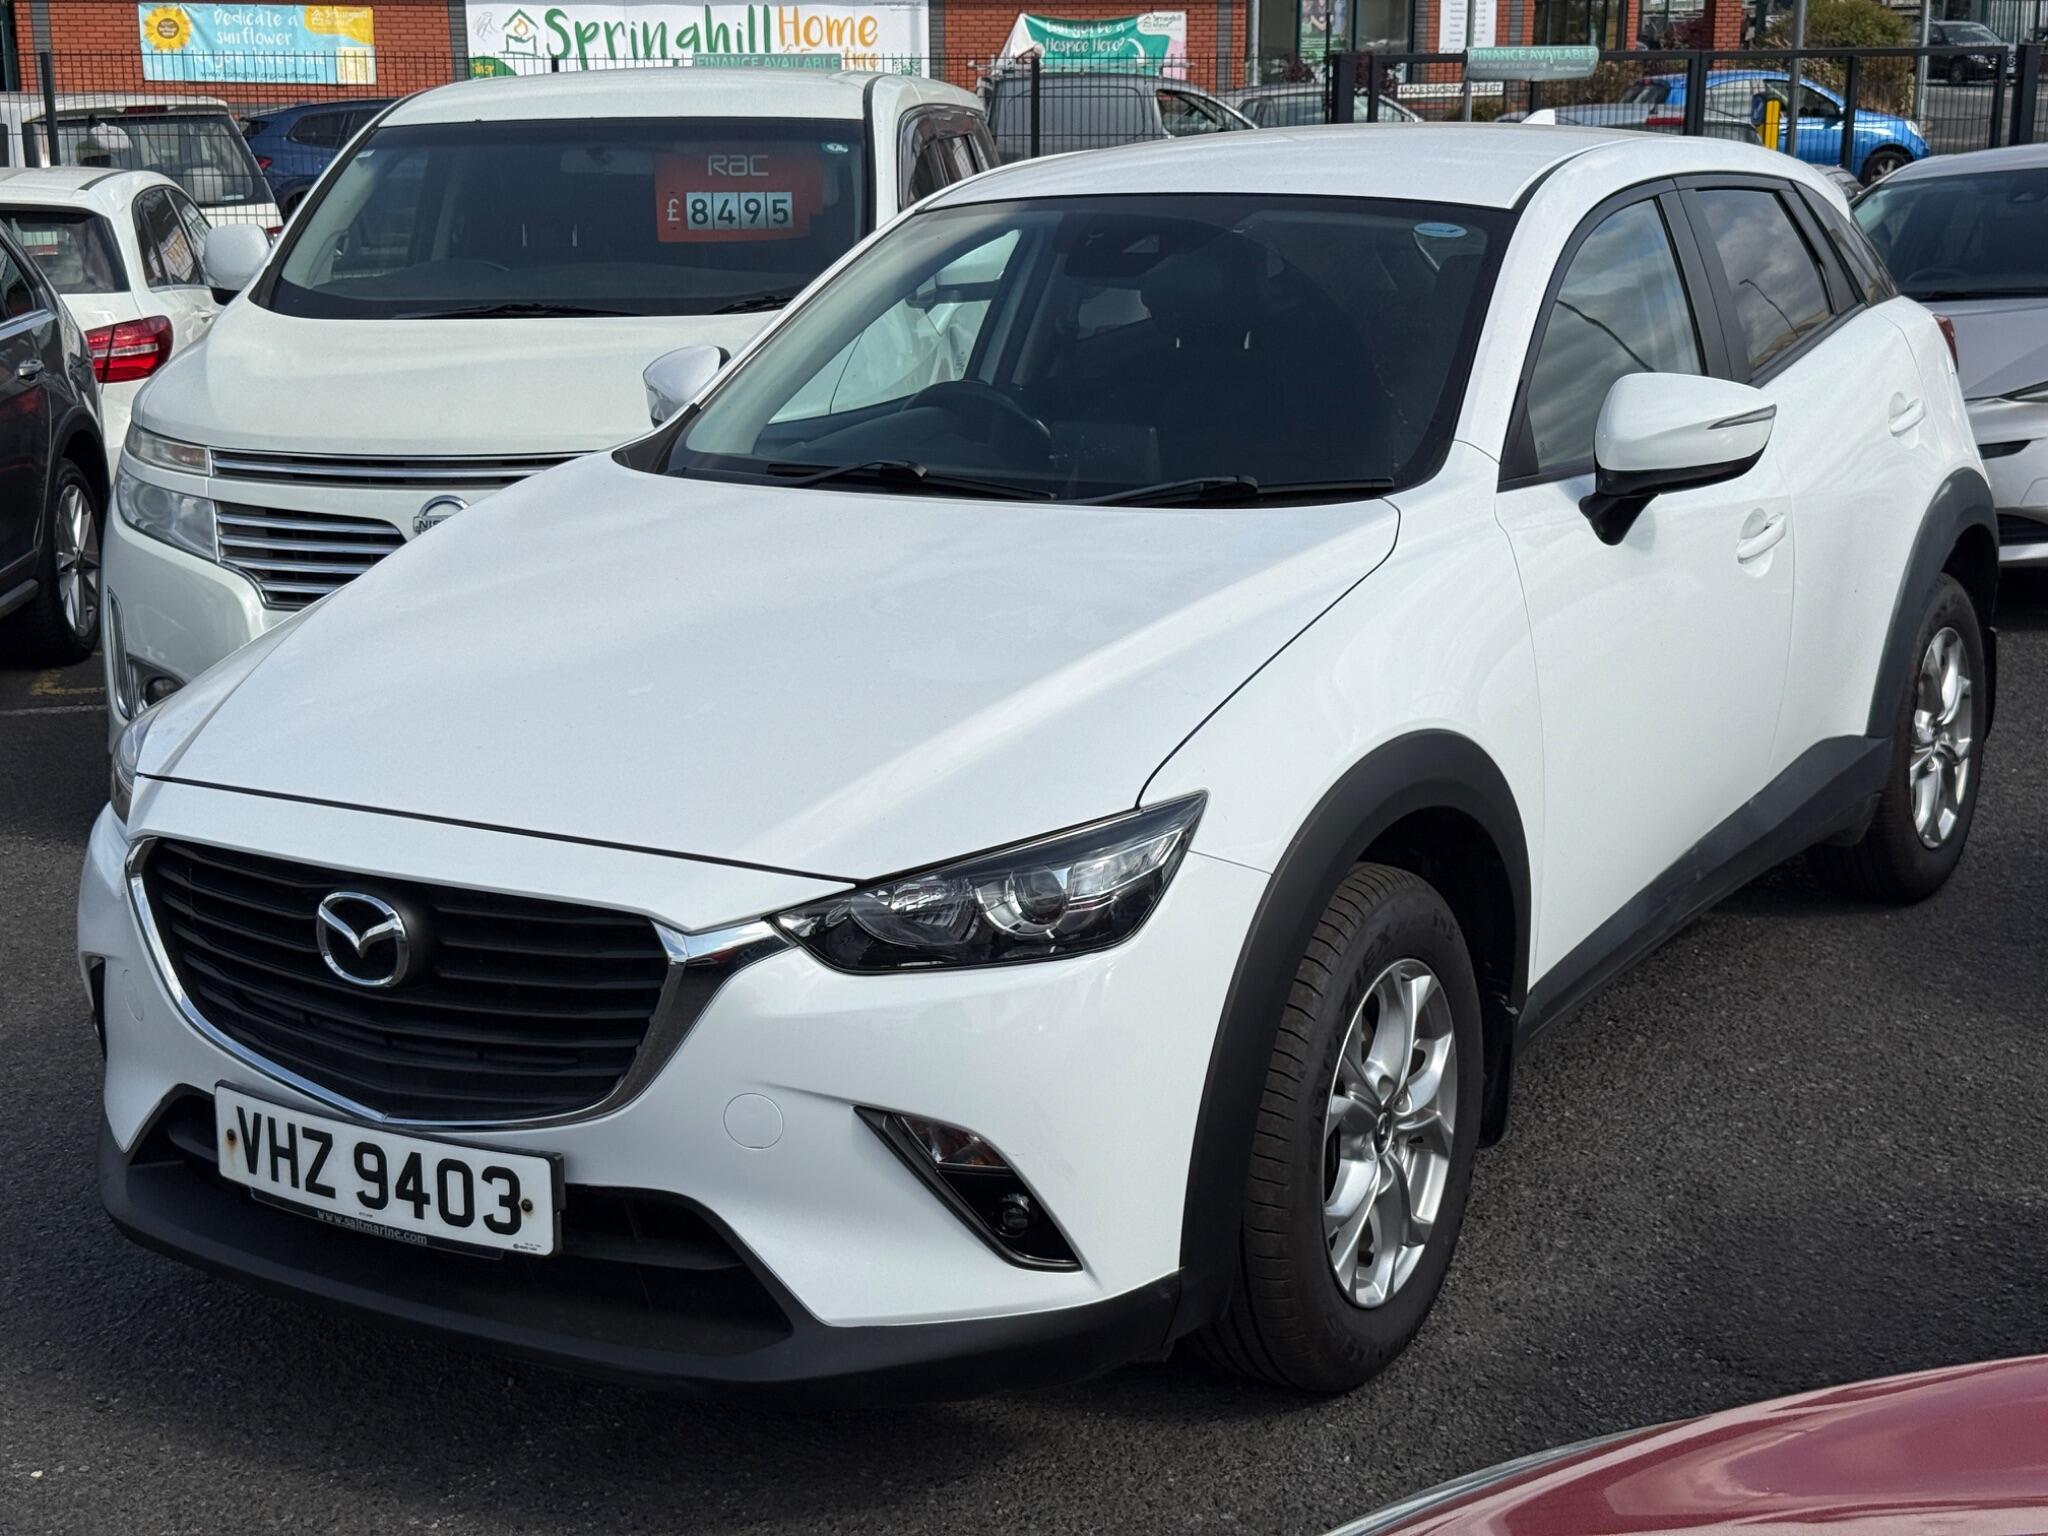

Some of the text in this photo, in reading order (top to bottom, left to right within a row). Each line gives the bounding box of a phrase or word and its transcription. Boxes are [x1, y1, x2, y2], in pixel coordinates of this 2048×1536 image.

[213, 9, 283, 27] Dedicate
[287, 14, 299, 27] a
[215, 26, 293, 45] sunflower
[545, 4, 879, 72] Springhill Home
[695, 56, 759, 68] FINANCE
[1470, 49, 1596, 62] FINANCE AVAILABLE
[236, 1105, 522, 1235] VHZ 9403
[316, 1210, 428, 1246] www.saltmarine.com
